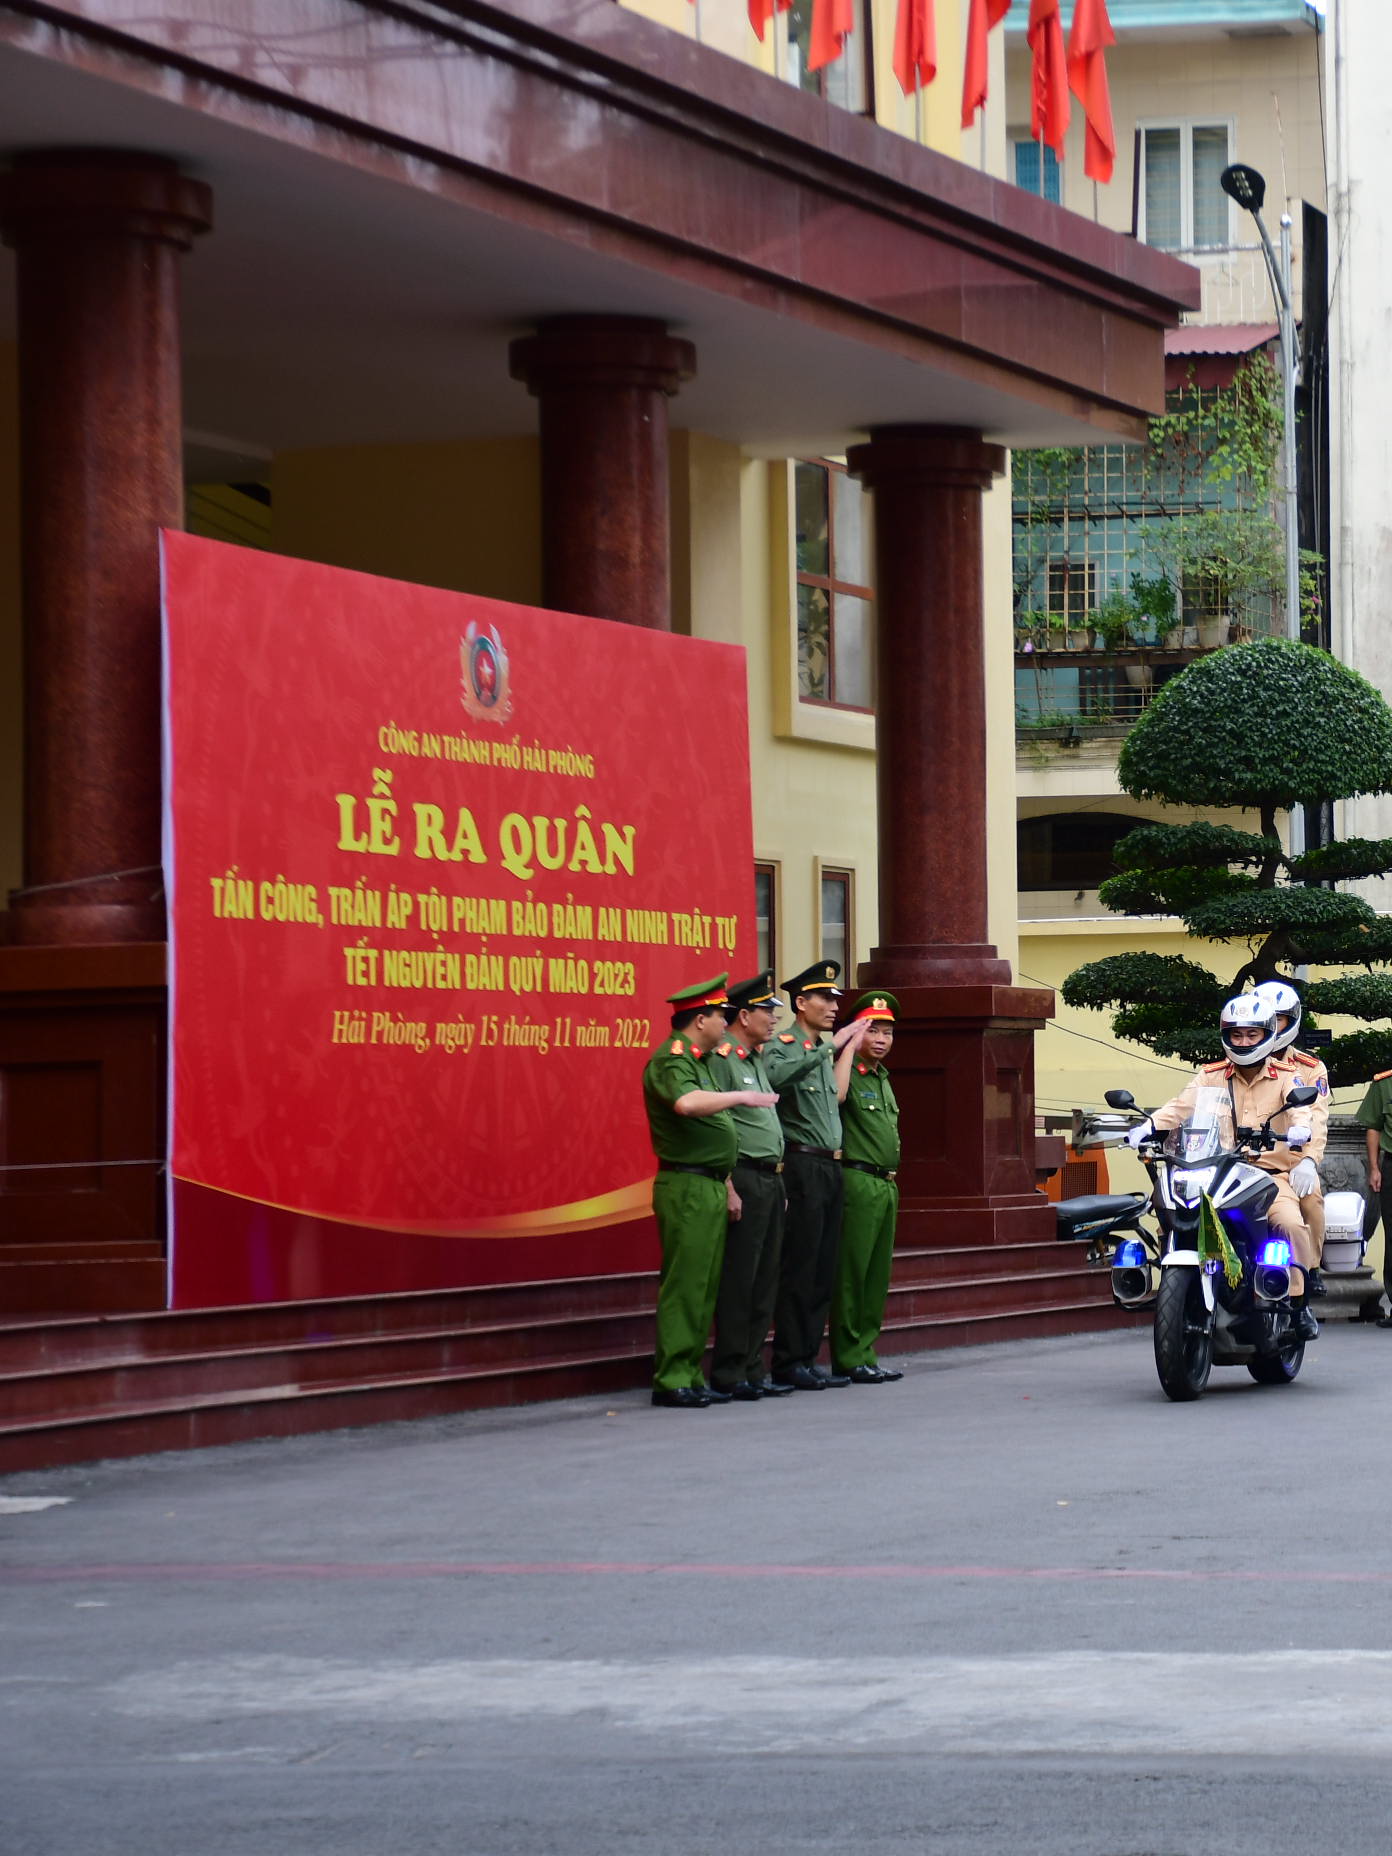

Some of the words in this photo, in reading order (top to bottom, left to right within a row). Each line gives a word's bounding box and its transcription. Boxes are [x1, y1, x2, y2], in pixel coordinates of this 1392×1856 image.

[378, 720, 418, 757] CÔNG
[421, 733, 442, 758] AN
[443, 730, 490, 766] THÀNH
[492, 734, 521, 769] PHỐ
[523, 739, 547, 773] HẢI
[549, 745, 595, 779] PHÒNG
[335, 767, 400, 856] LỄ
[413, 803, 488, 863] RA
[500, 804, 636, 880] QUÂN
[210, 864, 255, 919] TẤN
[260, 873, 325, 928] CÔNG,
[328, 875, 382, 928] TRẤN
[387, 883, 413, 929] ÁP
[417, 886, 448, 939] TỘI
[452, 895, 507, 942] PHẠM
[511, 890, 548, 938] BẢO
[552, 893, 593, 940] ĐẢM
[597, 907, 622, 942] AN
[626, 909, 668, 945] NINH
[671, 907, 712, 955] TRẬT
[715, 914, 737, 957] TỰ
[343, 936, 379, 986] TẾT
[383, 944, 461, 990] NGUYÊN
[465, 947, 504, 991] ĐÁN
[509, 950, 544, 996] QUÝ
[549, 952, 589, 994] MÃO
[593, 960, 636, 996] 2023
[332, 1010, 366, 1044] Hải
[370, 1011, 431, 1054] Phòng,
[436, 1013, 475, 1054] ngày
[480, 1015, 498, 1046] 15
[503, 1014, 549, 1055] tháng
[554, 1016, 571, 1047] 11
[576, 1019, 609, 1048] năm
[615, 1018, 650, 1048] 2022
